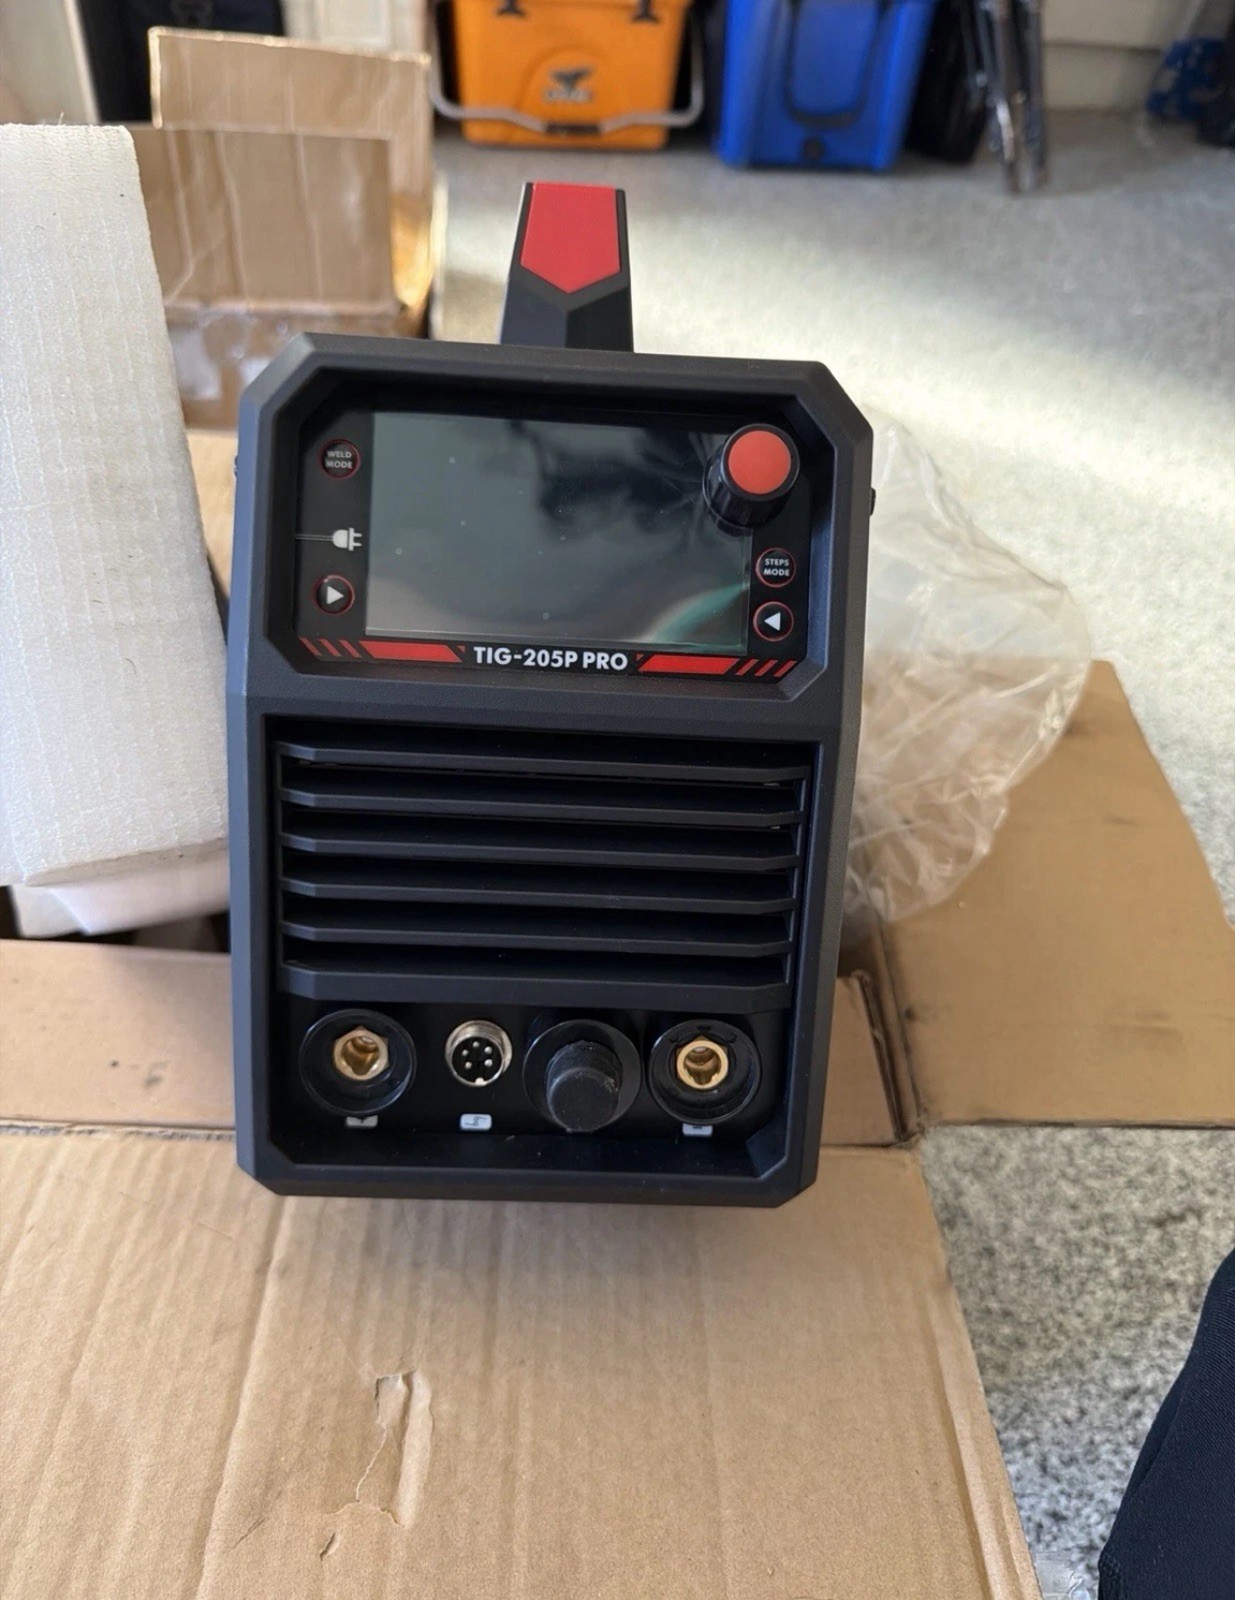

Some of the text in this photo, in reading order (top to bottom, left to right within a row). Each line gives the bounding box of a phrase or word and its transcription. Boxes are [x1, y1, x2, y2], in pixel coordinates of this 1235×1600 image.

[327, 450, 352, 459] WELD
[325, 460, 353, 469] MODE
[764, 558, 790, 567] STEPS
[763, 568, 790, 577] MODE
[473, 646, 628, 671] TIG-205P PRO
